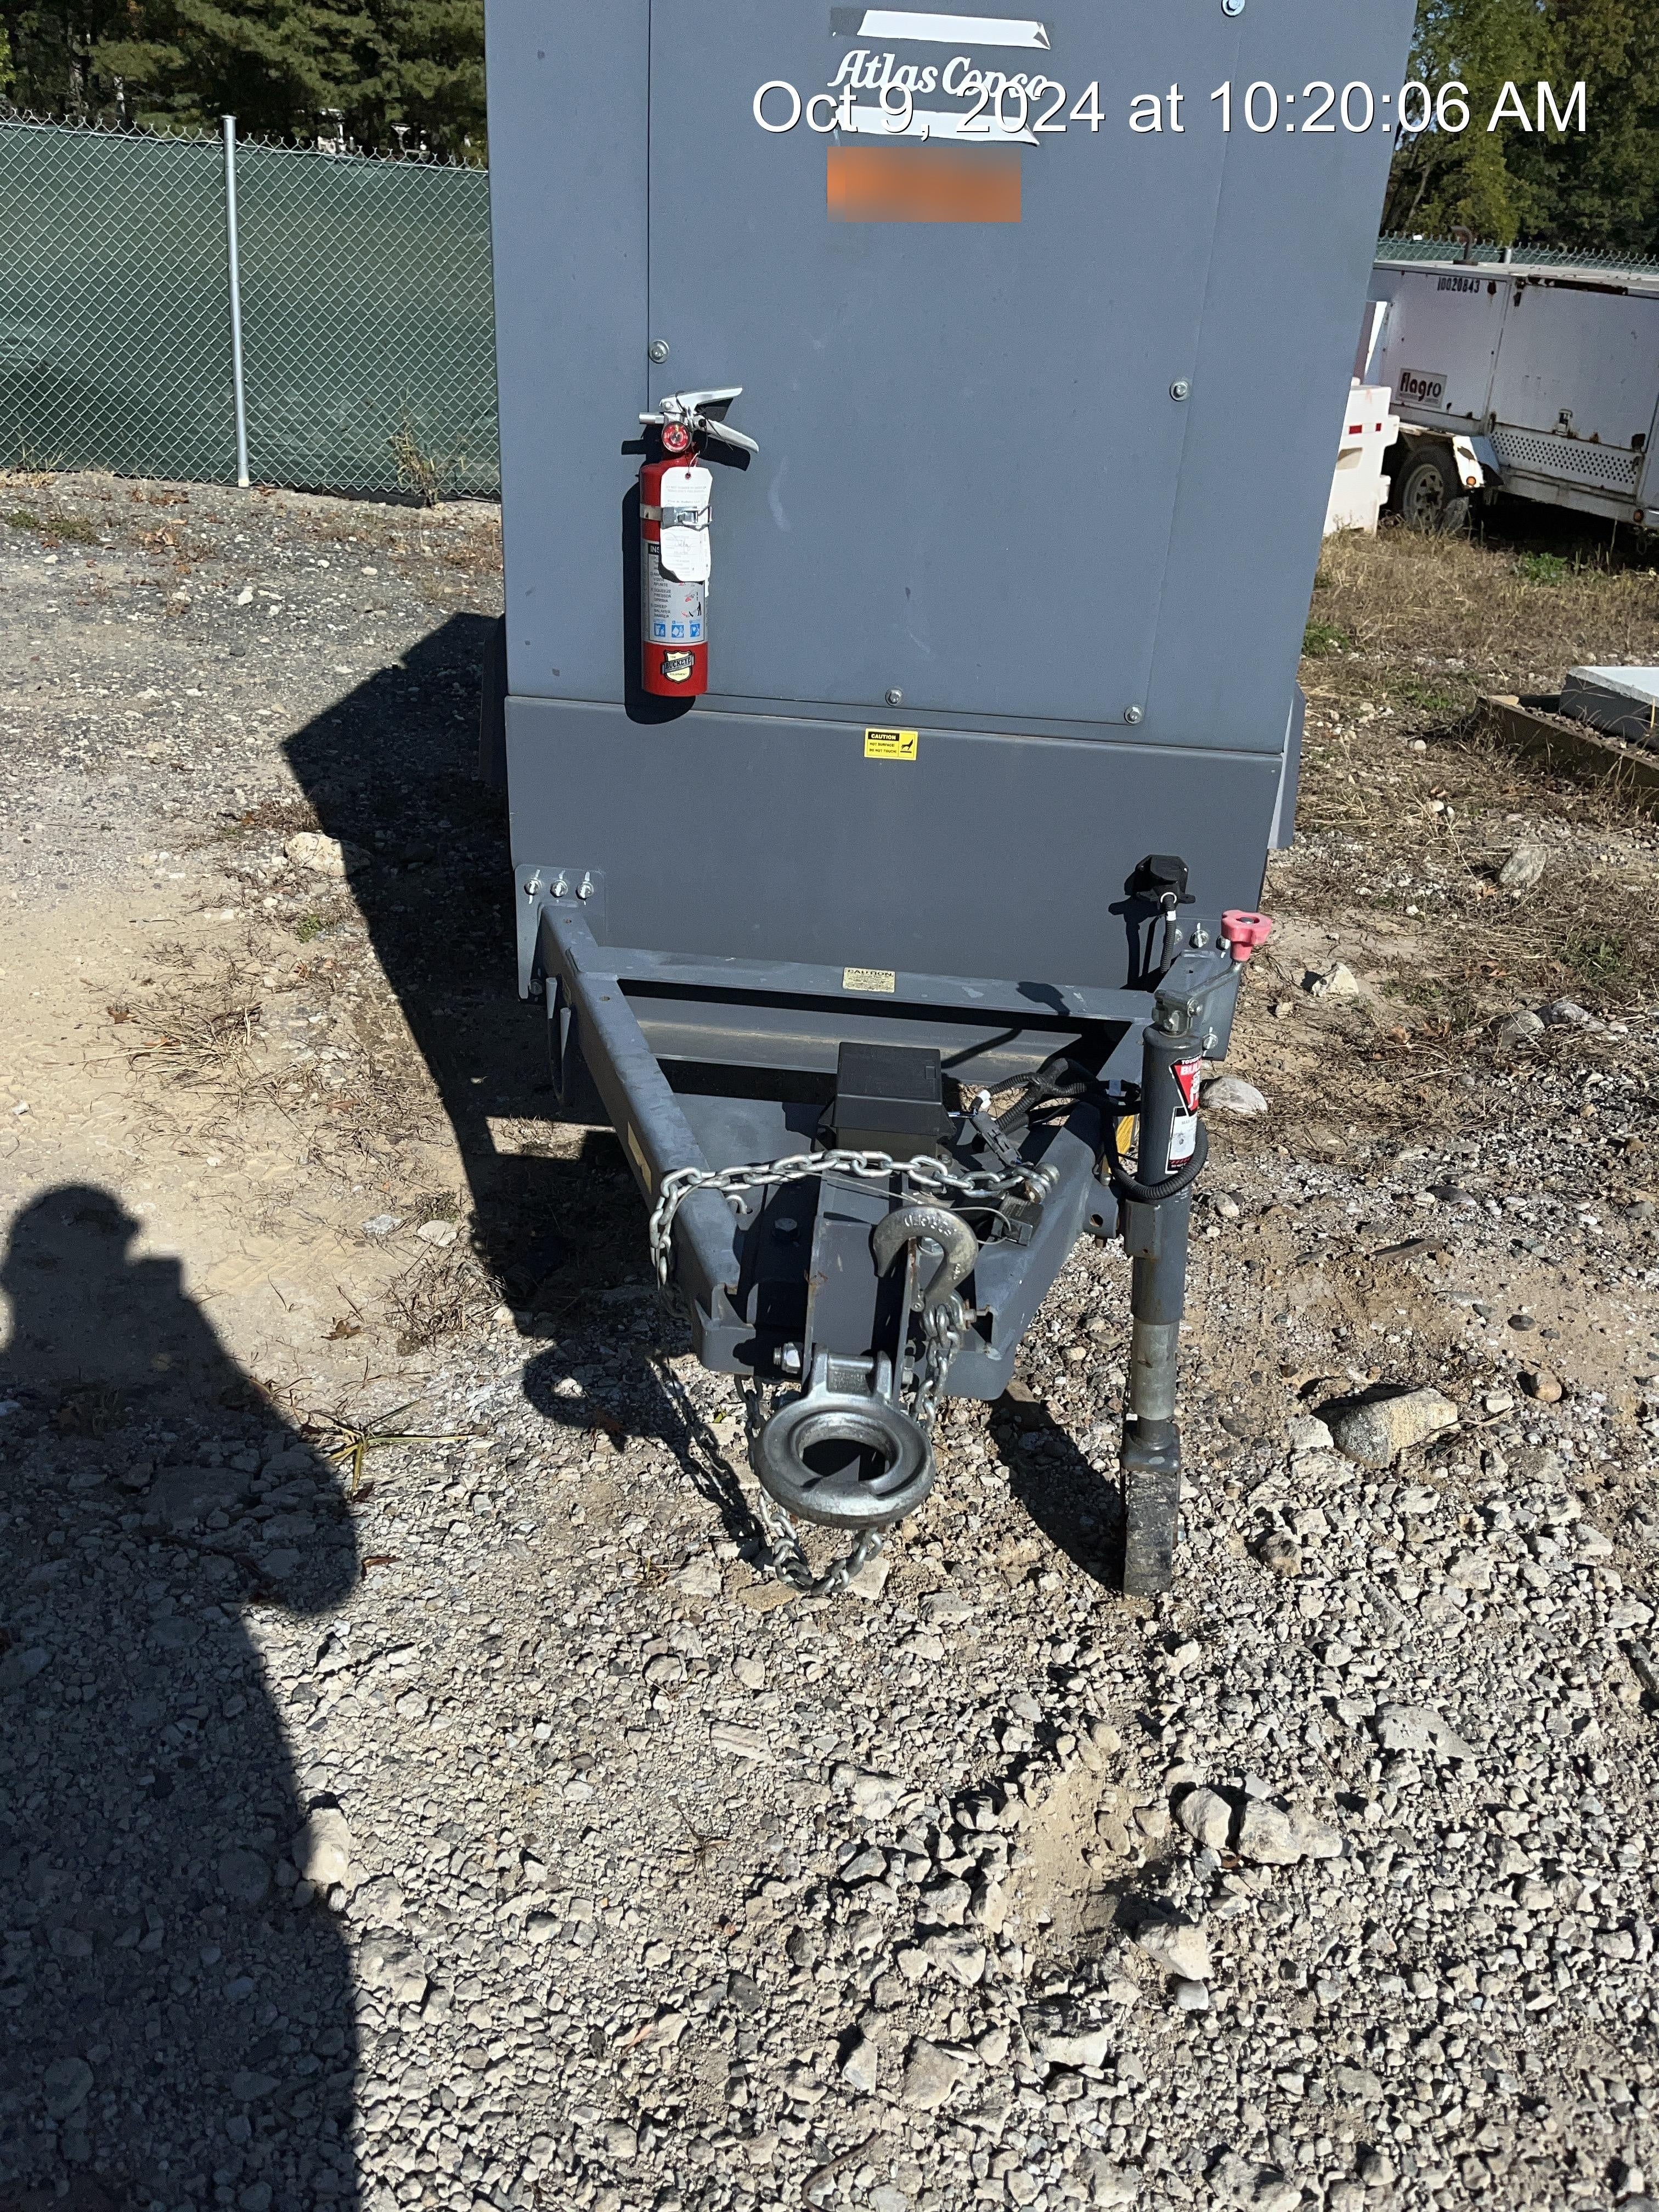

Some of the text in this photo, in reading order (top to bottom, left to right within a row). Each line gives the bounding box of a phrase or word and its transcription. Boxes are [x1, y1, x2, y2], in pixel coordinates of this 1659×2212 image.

[827, 50, 1048, 101] Atlas Copco
[1400, 372, 1441, 402] flagro
[665, 656, 691, 669] BUCKEYE
